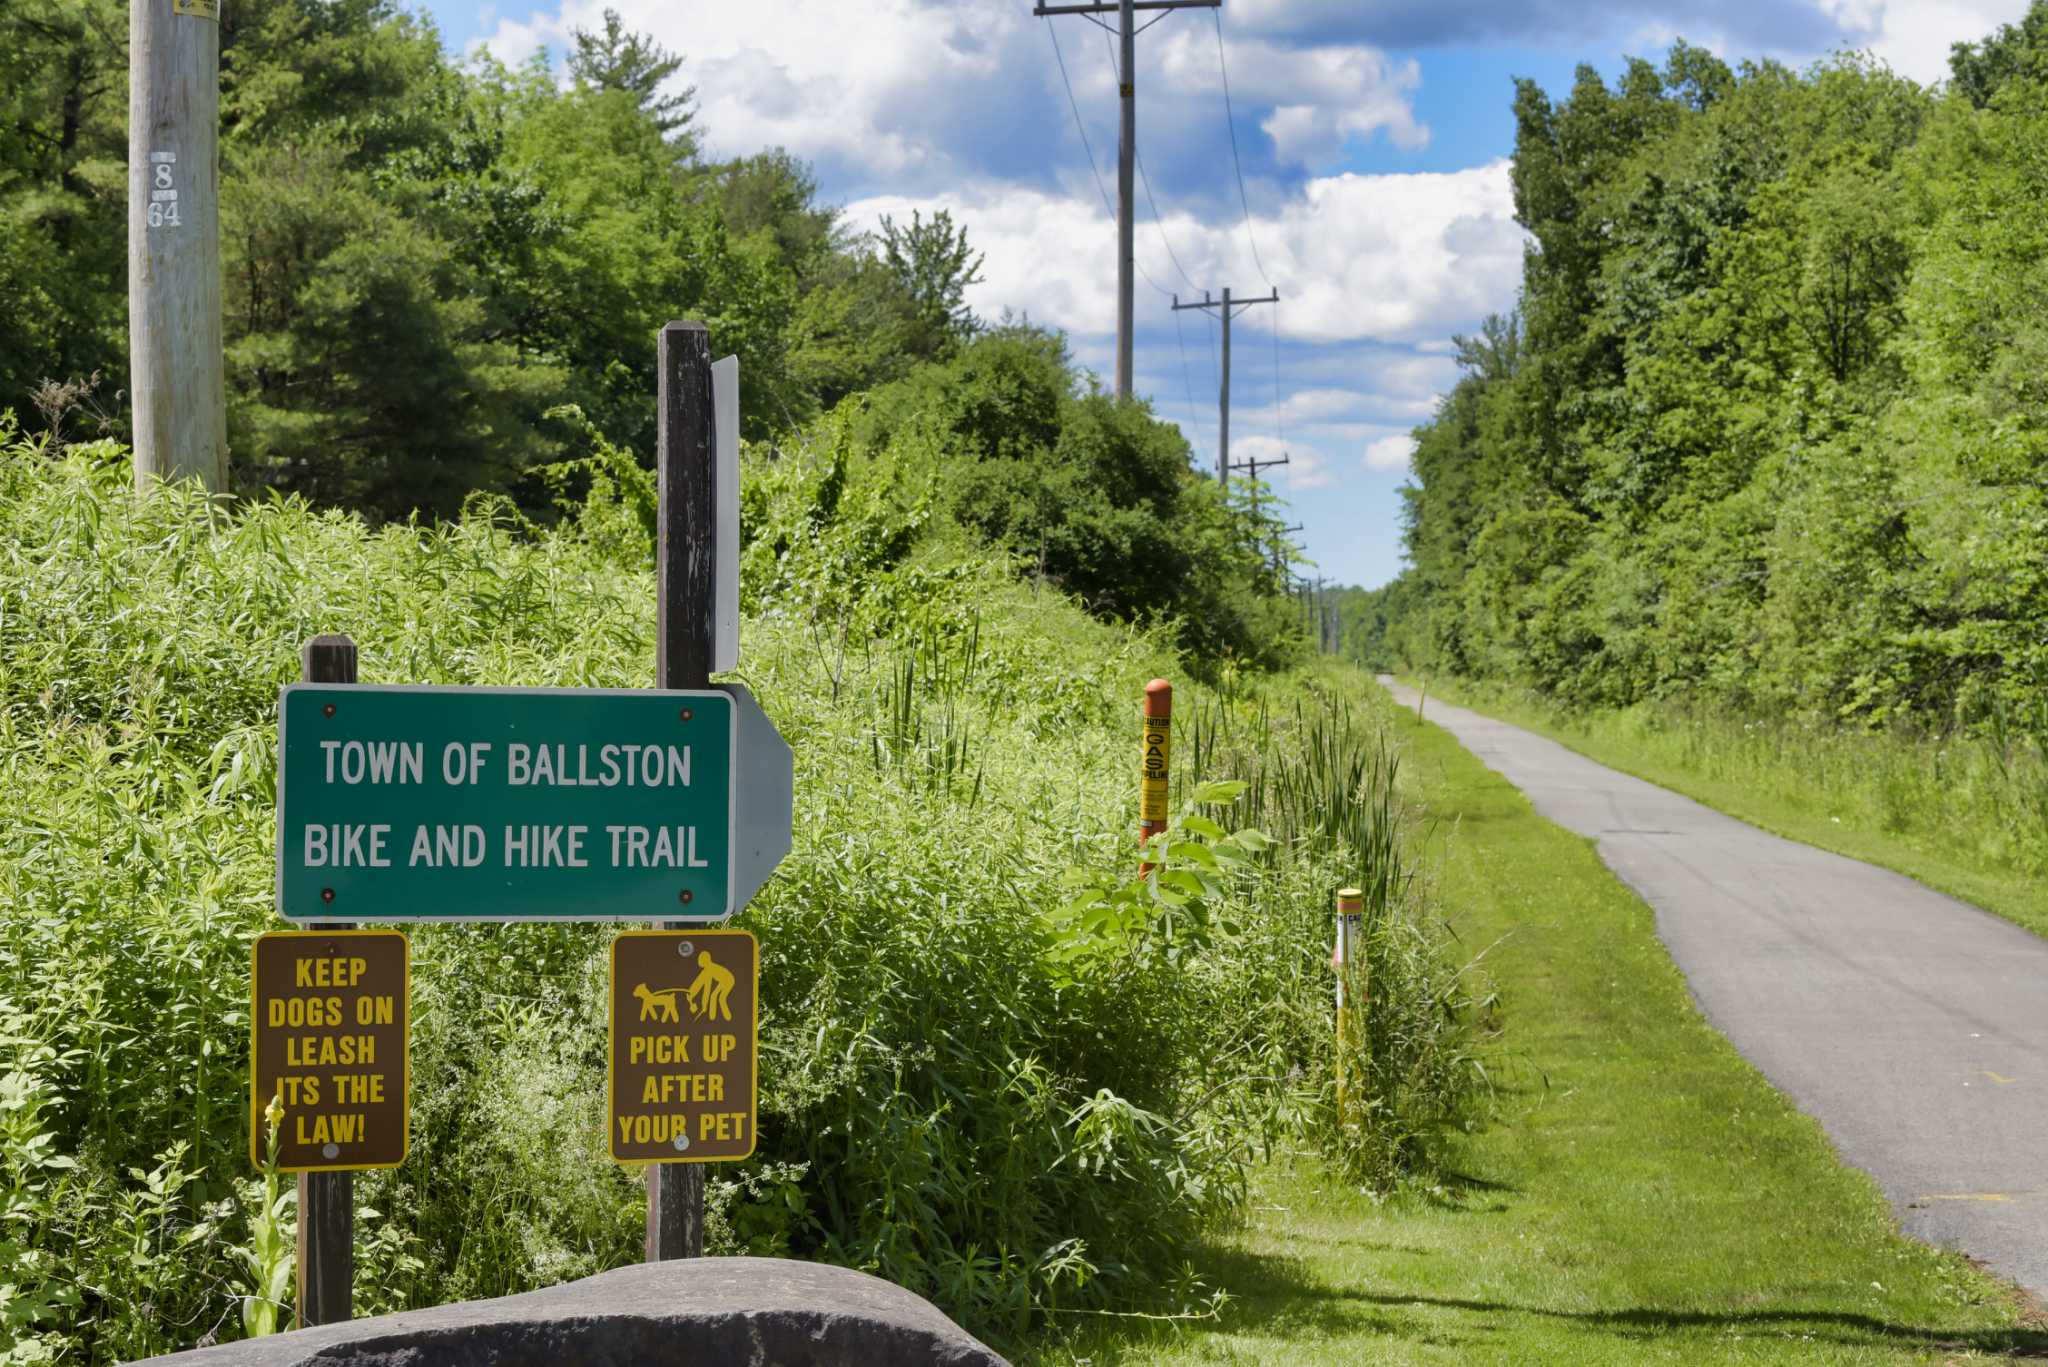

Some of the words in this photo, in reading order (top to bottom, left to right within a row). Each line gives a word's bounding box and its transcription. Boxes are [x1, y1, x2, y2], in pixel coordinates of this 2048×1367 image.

[155, 164, 173, 189] 8
[147, 201, 182, 227] 64
[320, 741, 423, 785] TOWN
[442, 742, 491, 785] OF
[507, 742, 692, 787] BALLSTON
[1146, 734, 1164, 769] GAS
[303, 823, 392, 867] BIKE
[408, 824, 487, 867] AND
[504, 825, 589, 867] HIKE
[606, 825, 709, 868] TRAIL
[296, 958, 367, 988] KEEP
[268, 997, 343, 1028] DOGS
[356, 996, 394, 1025] ON
[287, 1035, 375, 1067] LEASH
[630, 1035, 690, 1065] PICK
[703, 1034, 736, 1062] UP
[276, 1075, 321, 1106] ITS
[332, 1074, 385, 1104] THE
[642, 1074, 725, 1104] AFTER
[296, 1114, 365, 1145] LAW!
[618, 1114, 687, 1144] YOUR
[700, 1112, 747, 1141] PET
